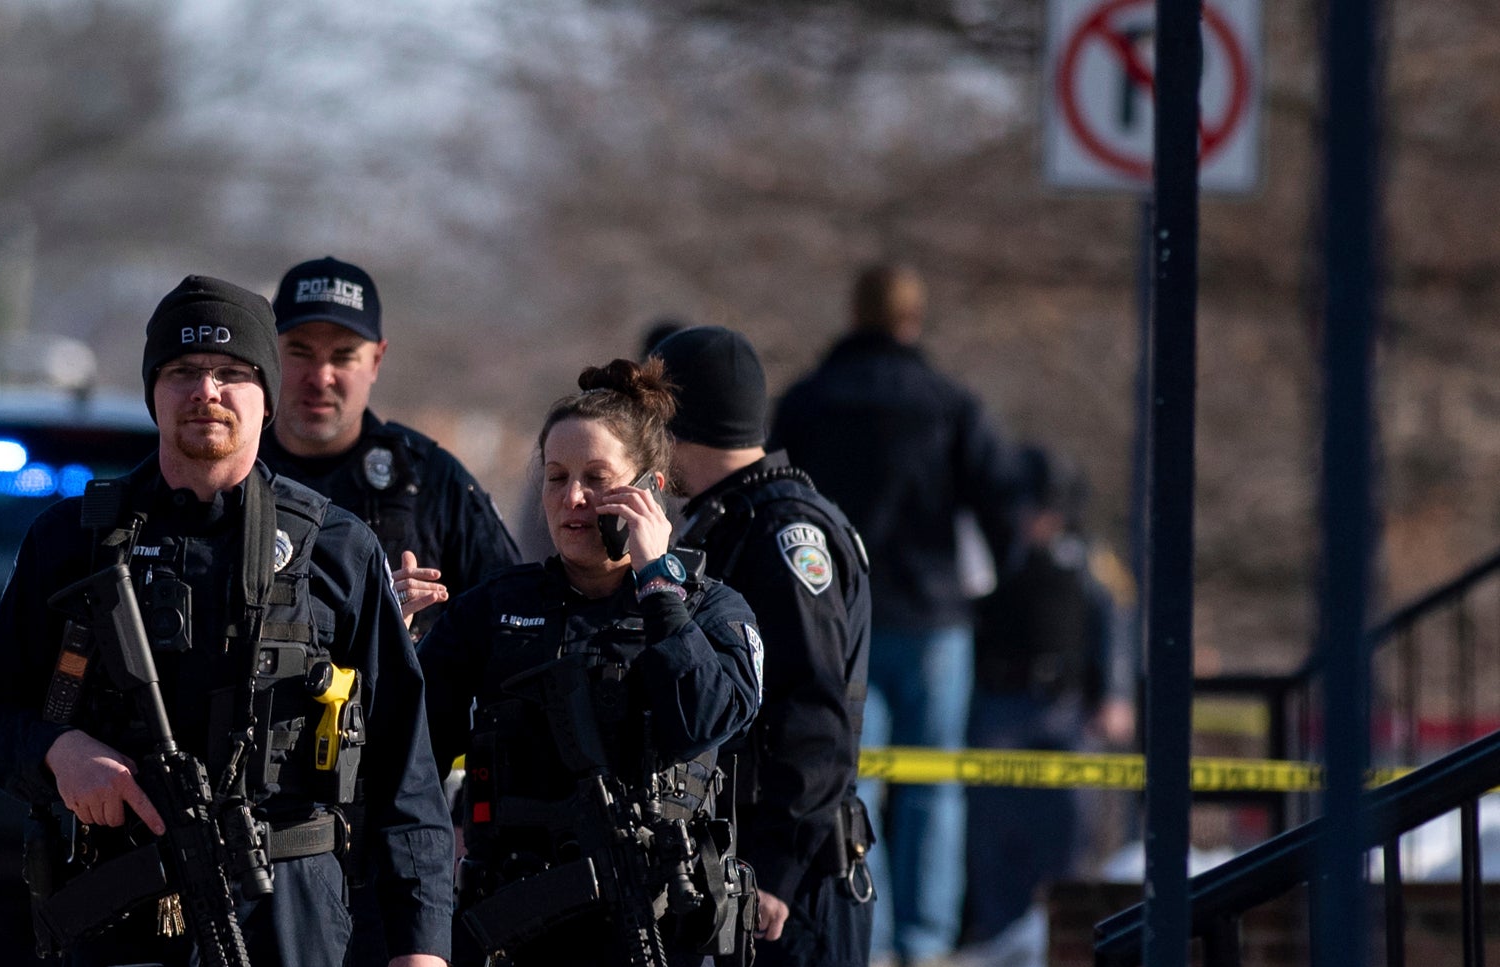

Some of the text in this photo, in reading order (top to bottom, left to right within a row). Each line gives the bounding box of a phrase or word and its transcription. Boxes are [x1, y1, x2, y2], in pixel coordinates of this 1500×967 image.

[296, 277, 364, 302] POLICE
[181, 325, 231, 344] BPD
[132, 545, 161, 556] OTNIK
